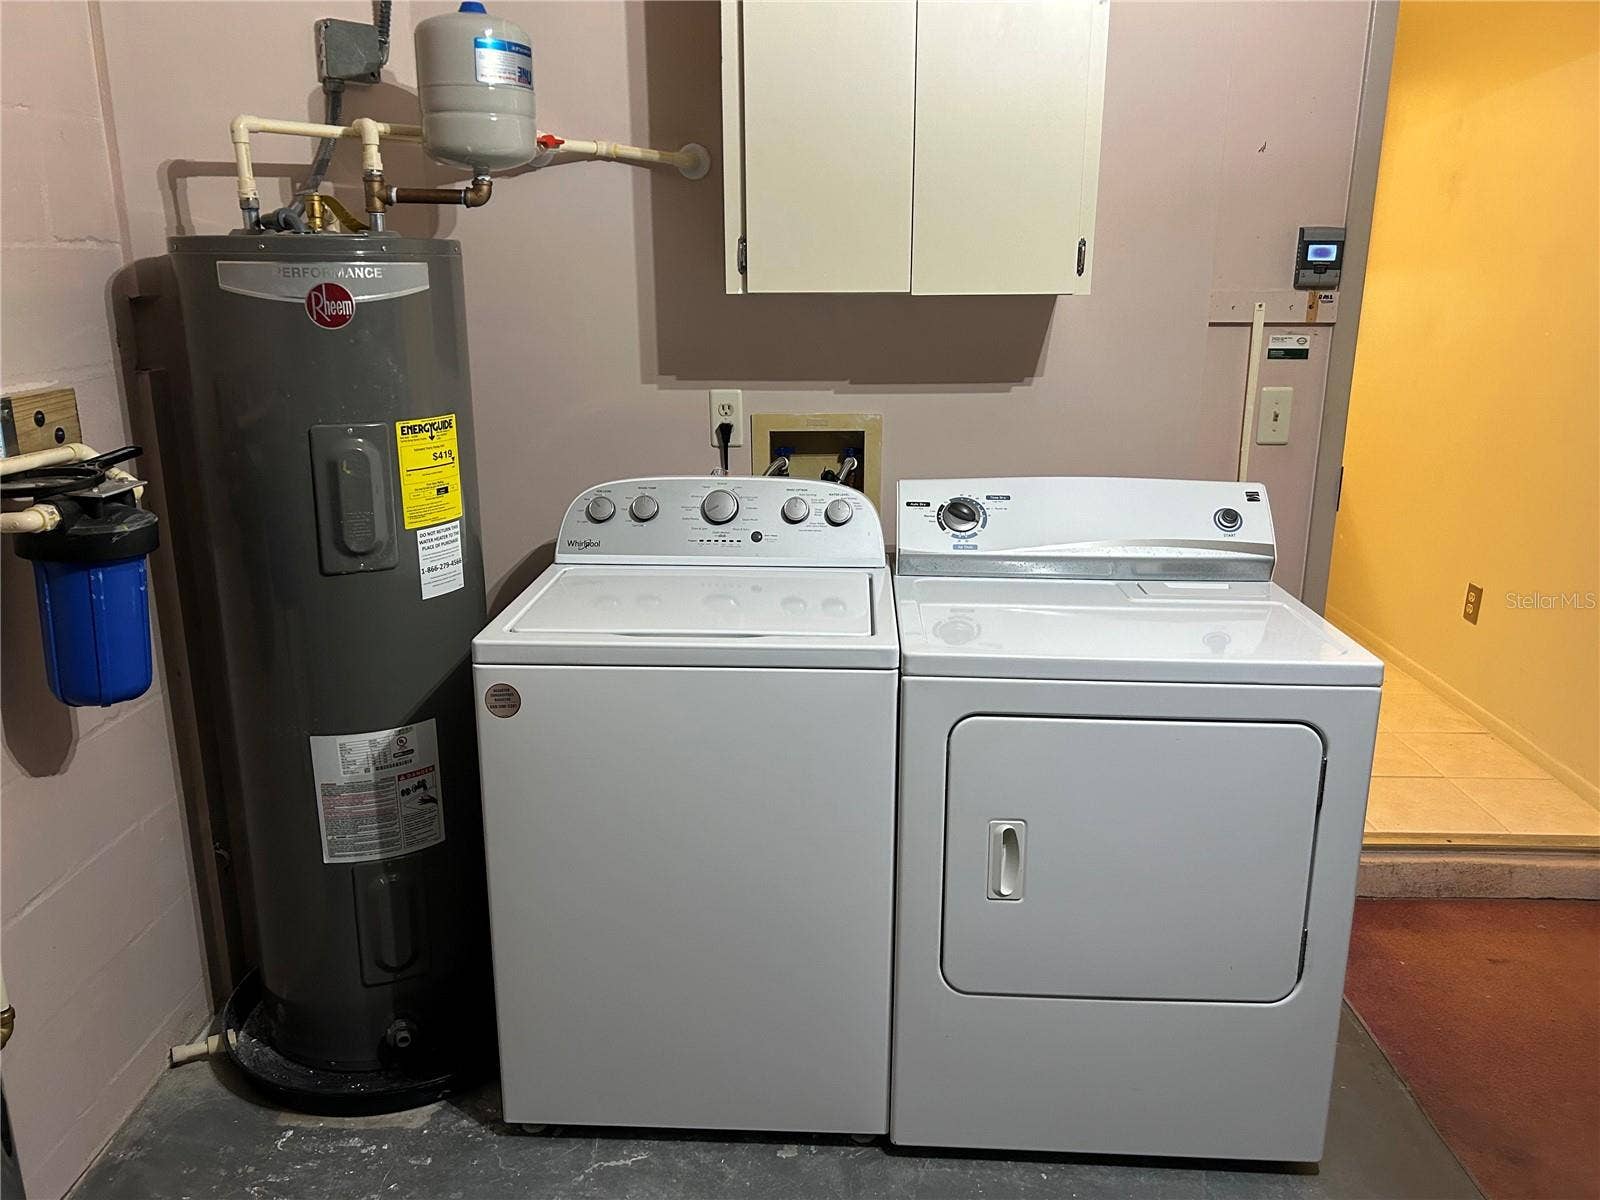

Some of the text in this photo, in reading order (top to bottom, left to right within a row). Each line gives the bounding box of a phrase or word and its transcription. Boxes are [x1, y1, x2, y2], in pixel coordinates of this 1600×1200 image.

[311, 283, 353, 321] Rheem
[400, 419, 453, 437] ENERGYGUIDE
[432, 449, 453, 461] $419
[418, 537, 434, 545] WATER
[567, 539, 601, 550] Whirlpool
